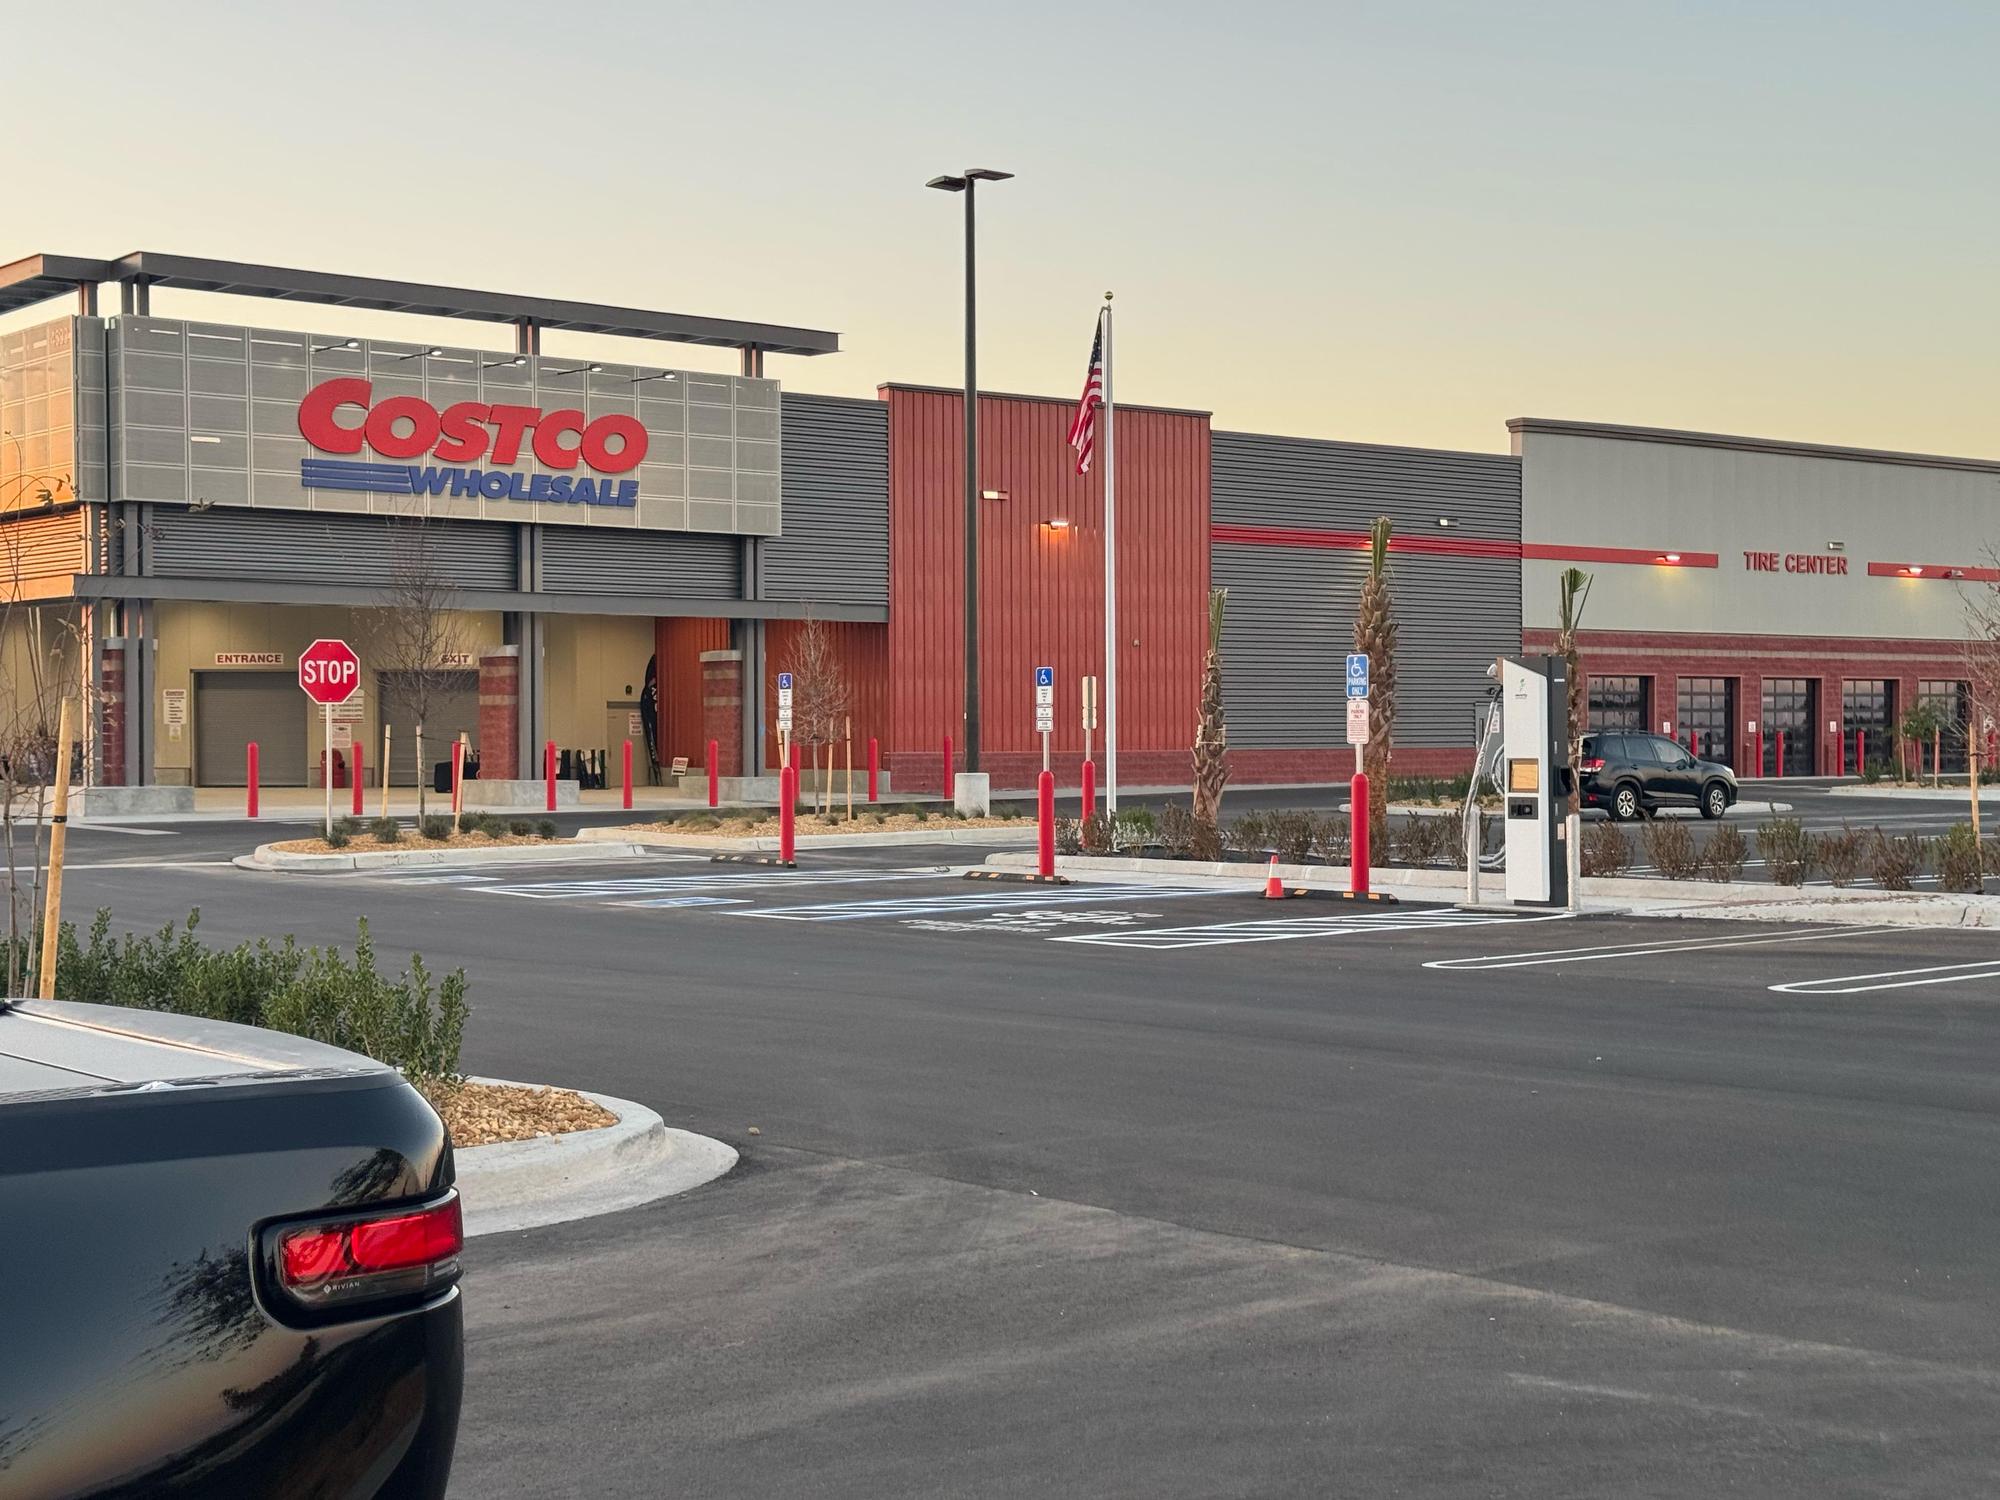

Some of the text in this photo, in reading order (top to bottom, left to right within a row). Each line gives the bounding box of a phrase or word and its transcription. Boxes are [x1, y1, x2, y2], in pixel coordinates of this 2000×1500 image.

[298, 377, 649, 473] COSTCO
[408, 466, 639, 507] WHOLESALE
[1743, 552, 1847, 575] TIRE CENTER
[217, 654, 282, 663] ENTRANCE
[441, 654, 469, 663] EXIT
[304, 660, 355, 684] STOP
[1348, 677, 1367, 686] PARKING
[1351, 686, 1364, 696] ONLY
[332, 1281, 360, 1290] RIVIAN
